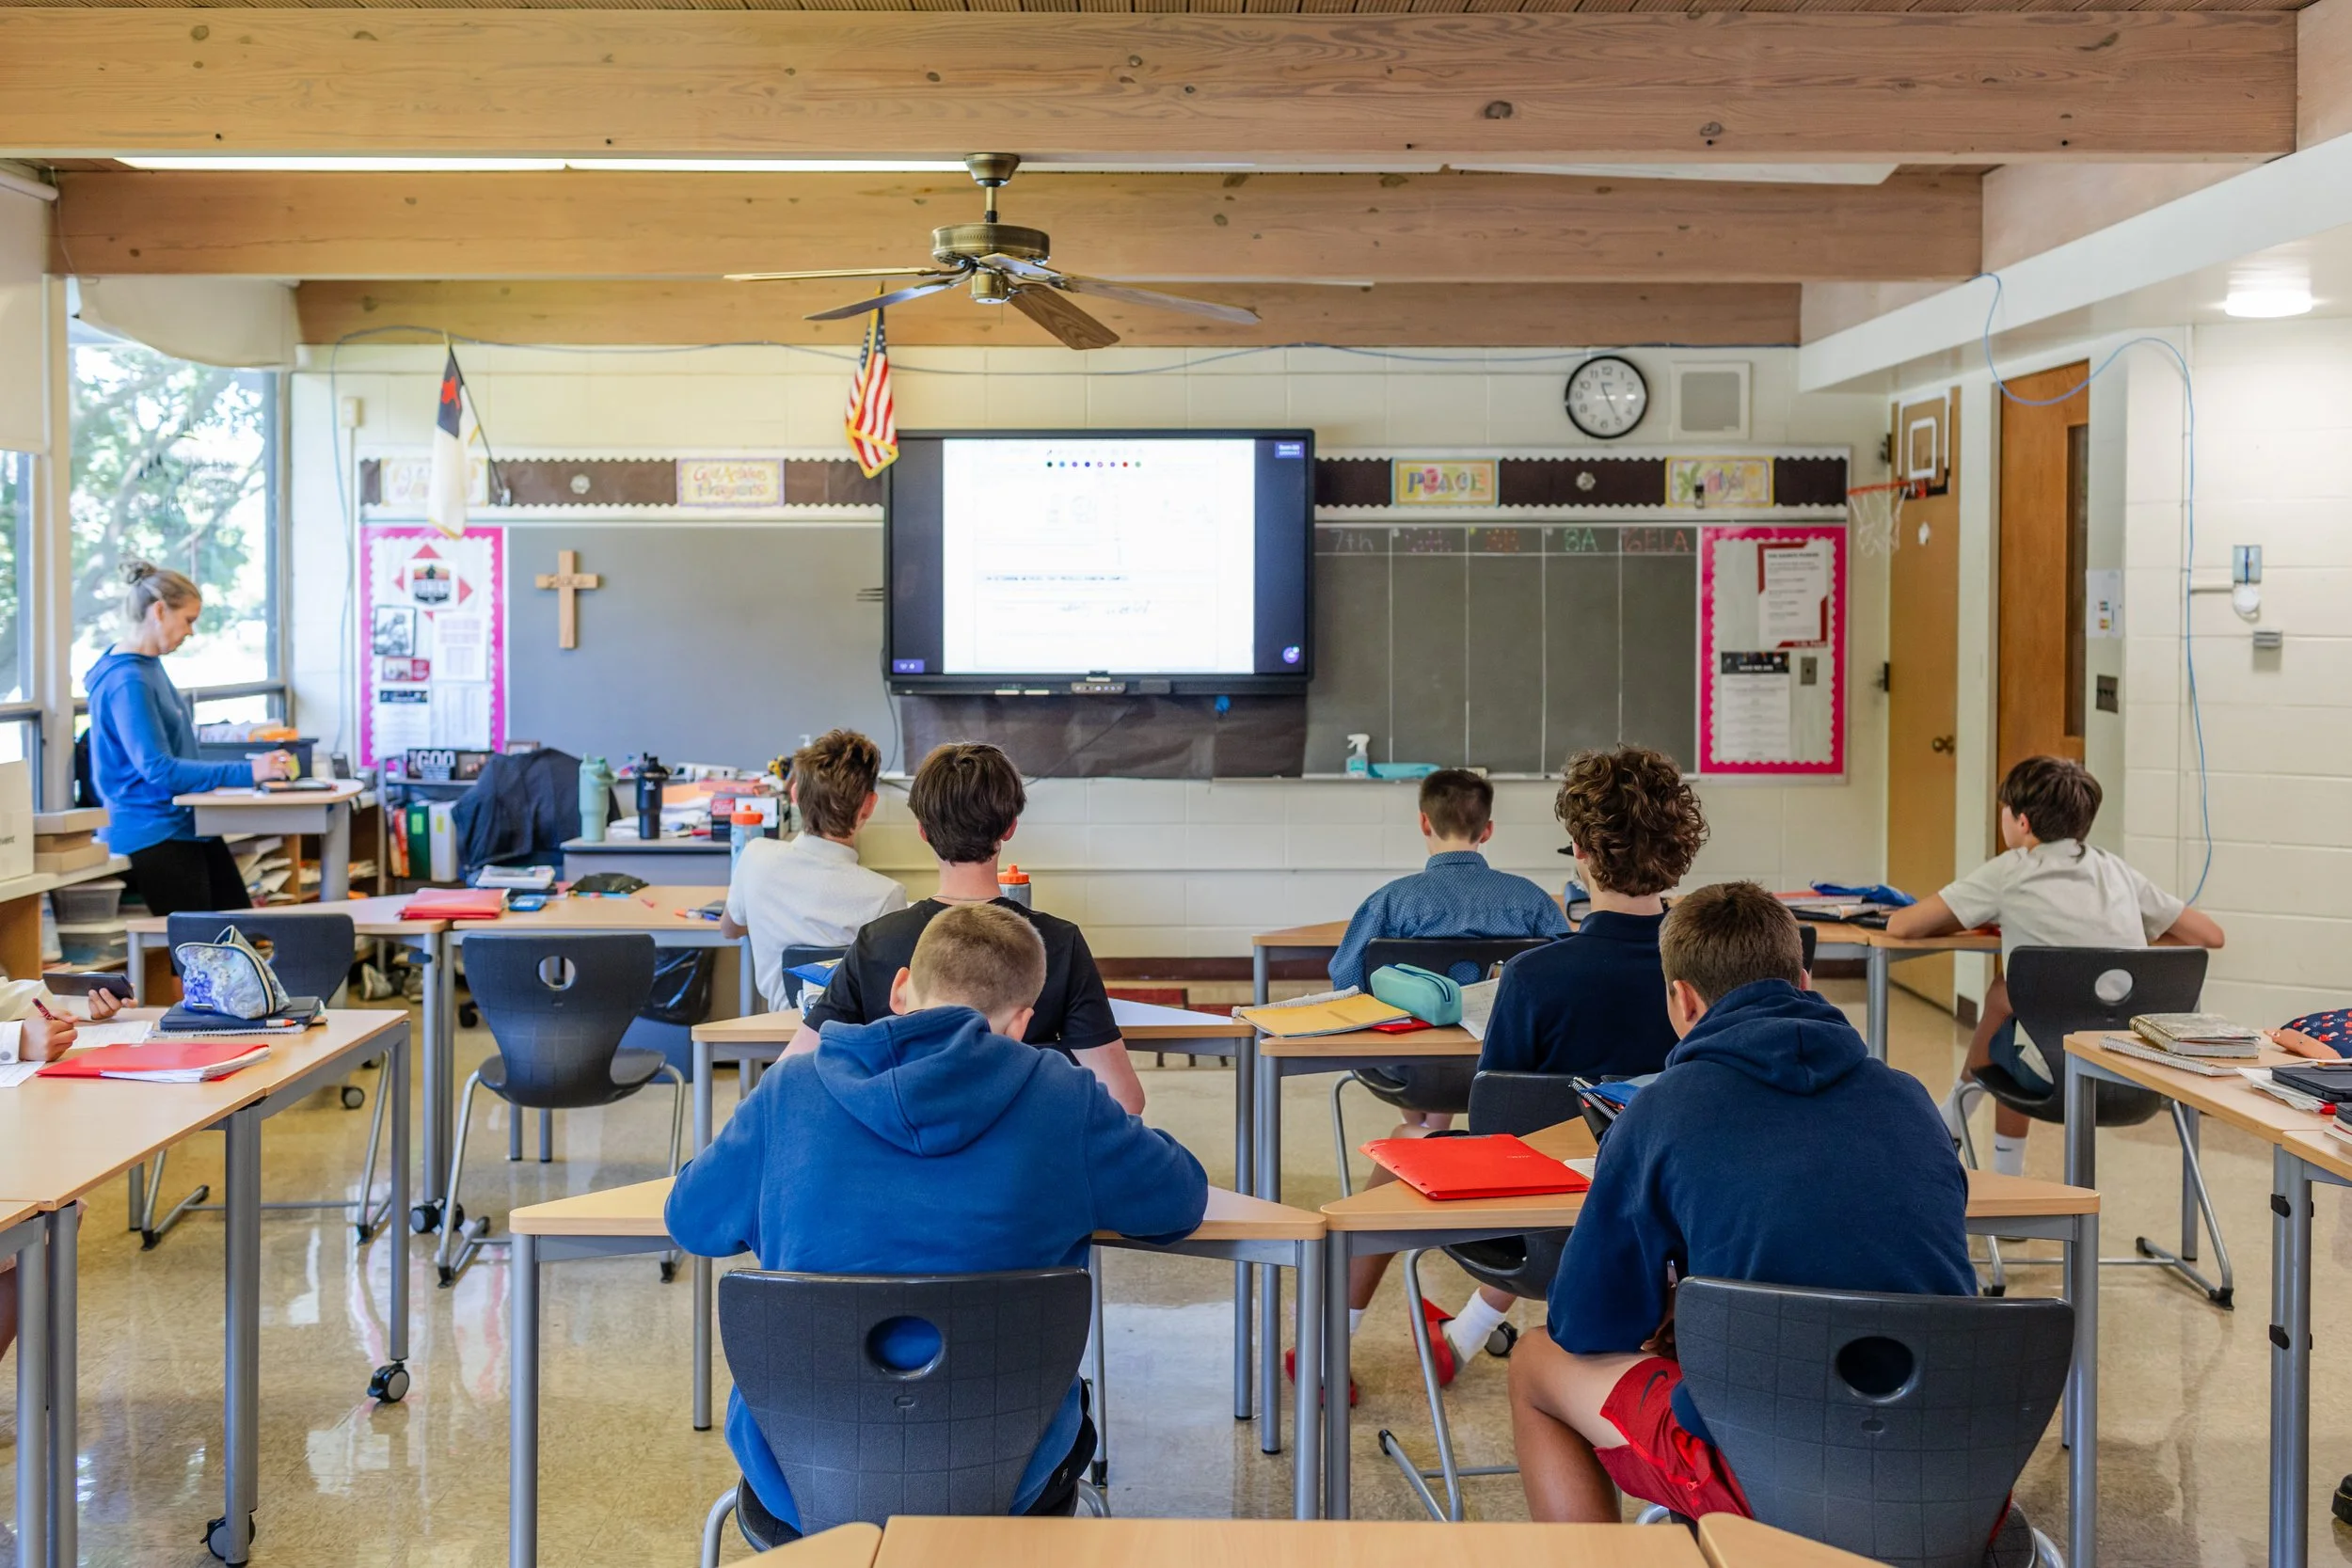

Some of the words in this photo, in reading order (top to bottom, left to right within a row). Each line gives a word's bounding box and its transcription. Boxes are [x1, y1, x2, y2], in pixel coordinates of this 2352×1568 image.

[1407, 467, 1486, 495] PEACE
[1328, 528, 1375, 553] 7th
[1564, 526, 1599, 553] 8A
